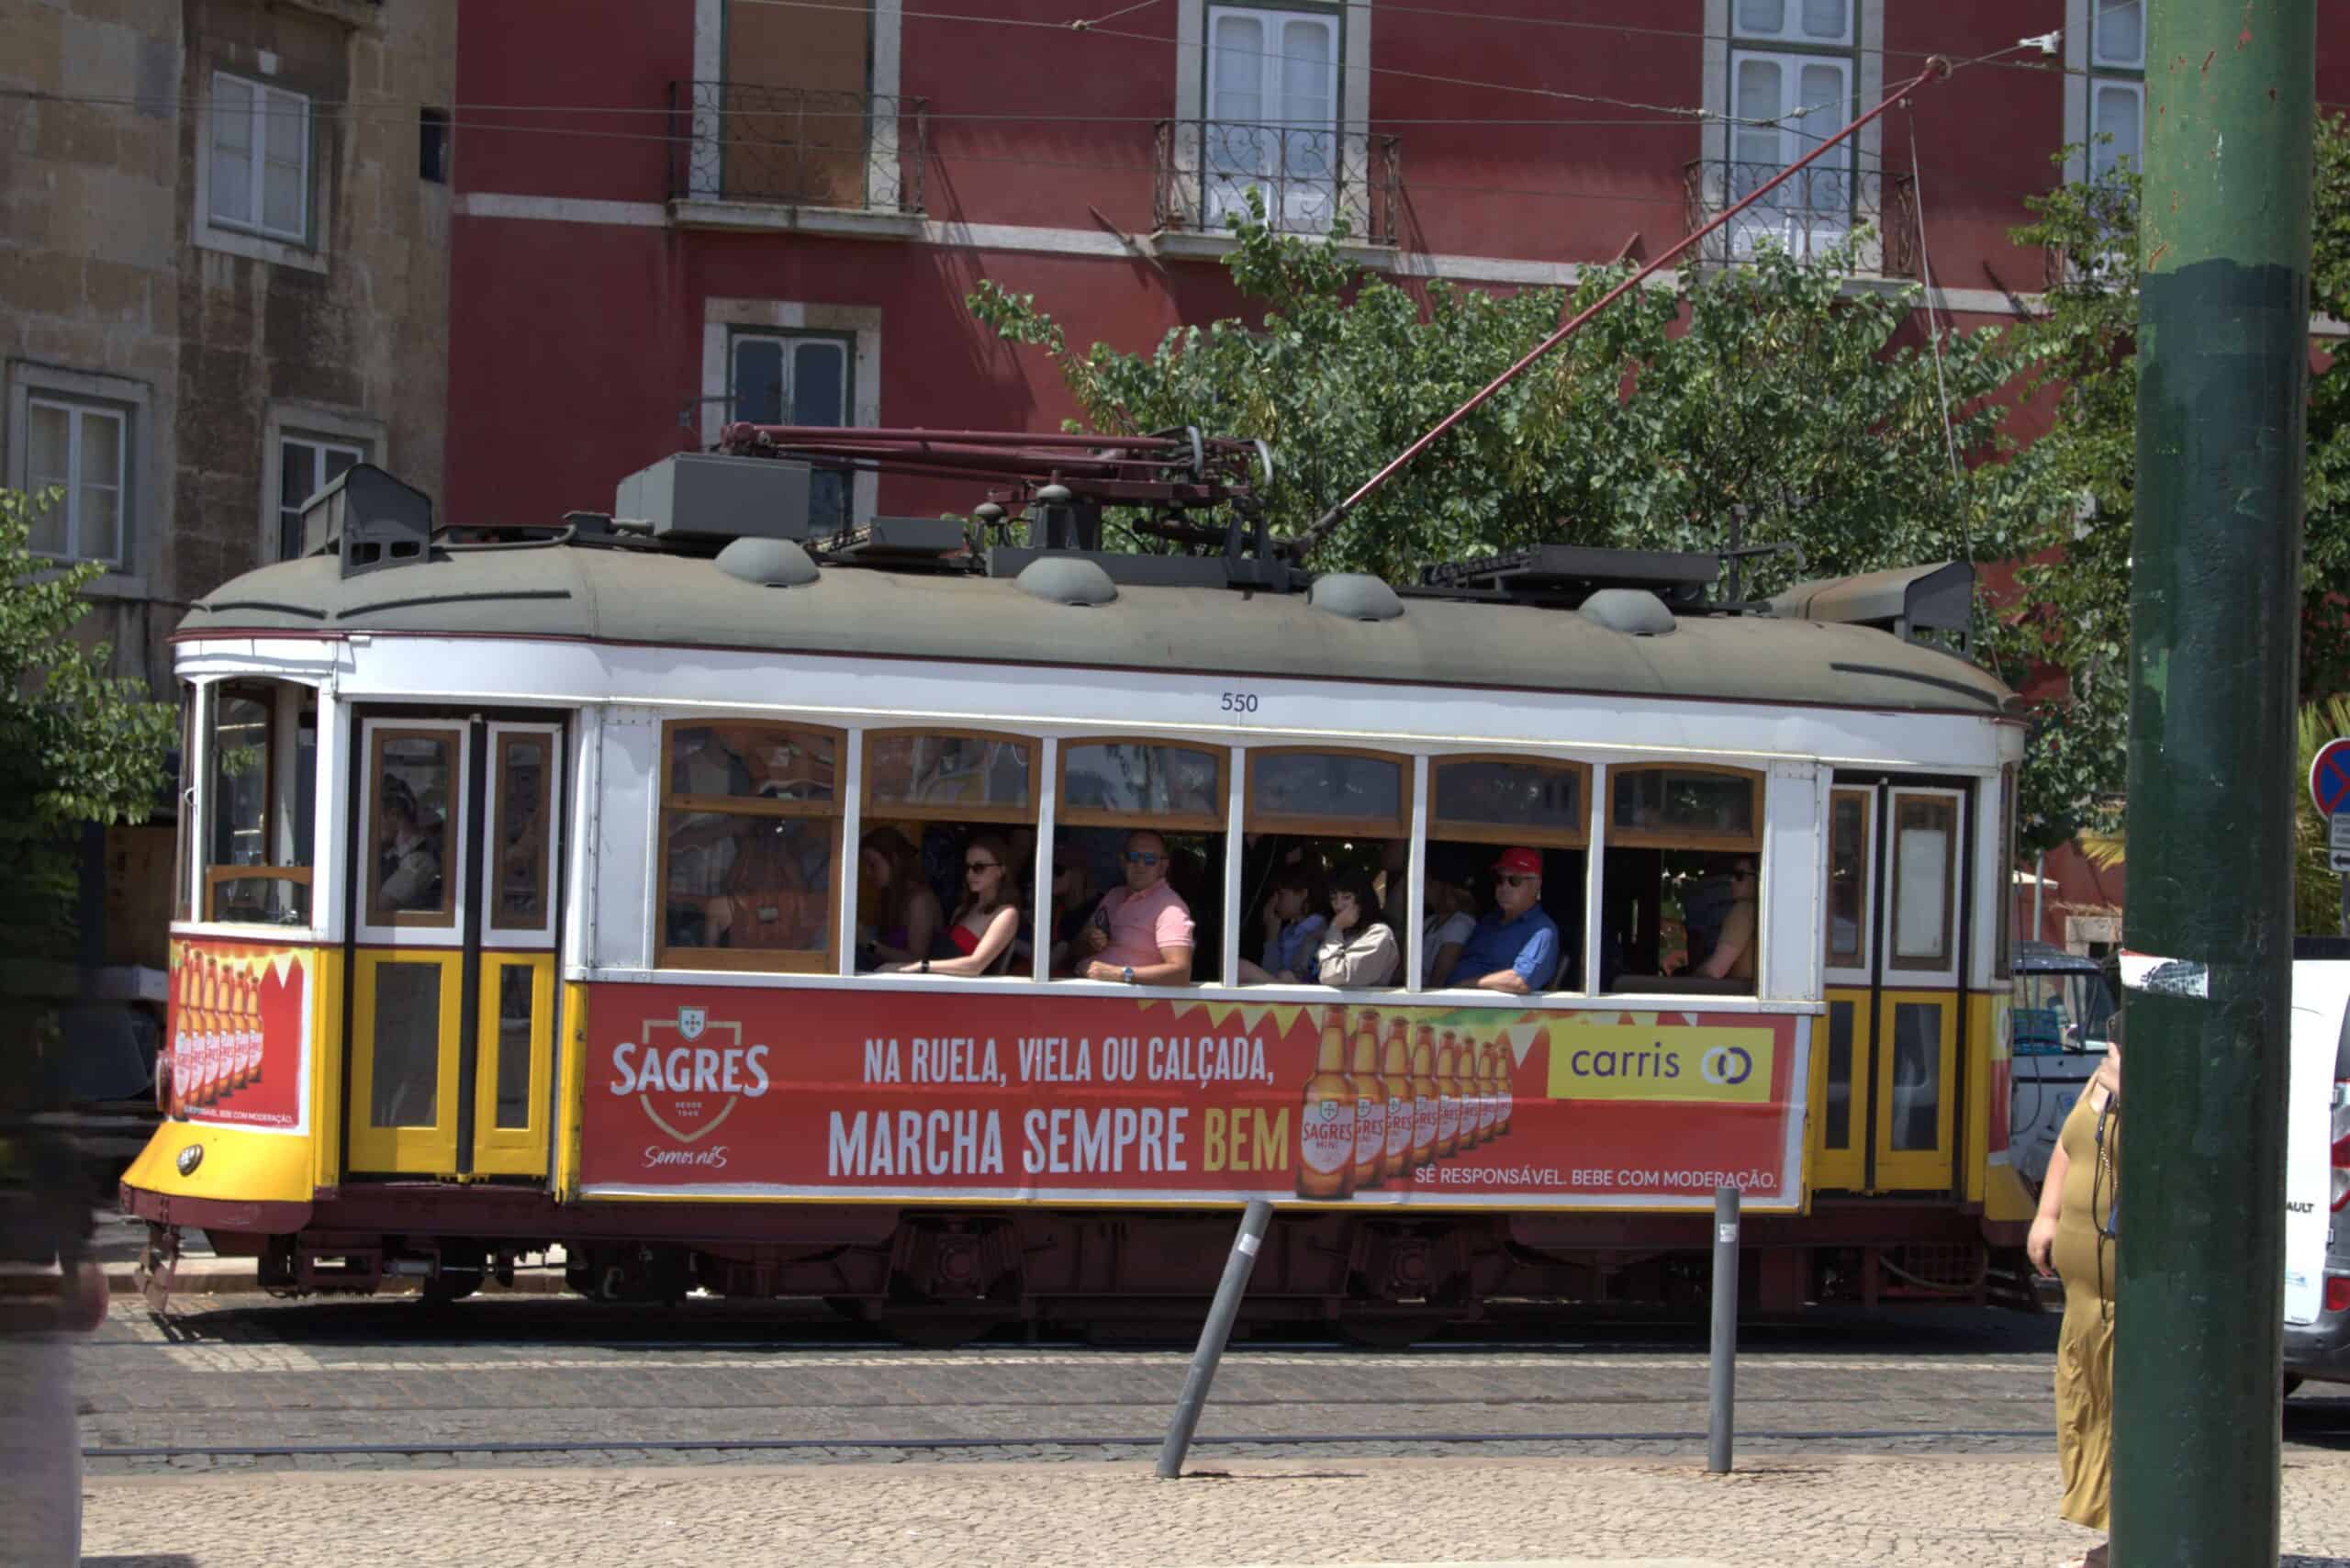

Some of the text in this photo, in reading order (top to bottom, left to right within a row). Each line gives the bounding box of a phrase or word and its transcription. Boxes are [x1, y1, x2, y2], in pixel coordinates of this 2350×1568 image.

[1221, 692, 1258, 712] 550
[610, 1042, 769, 1098] SAGRES
[864, 1036, 1274, 1089] NA RUELA, VIELA OU CALÇADA,
[1572, 1041, 1681, 1079] carris
[828, 1107, 1290, 1177] MARCHA SEMPRE BEM
[1304, 1122, 1353, 1142] SAGRES
[1415, 1162, 1777, 1192] SÊ RESPONSÁVEL. BEBE COM MODERAÇÃO.
[2285, 1201, 2314, 1213] AULT
